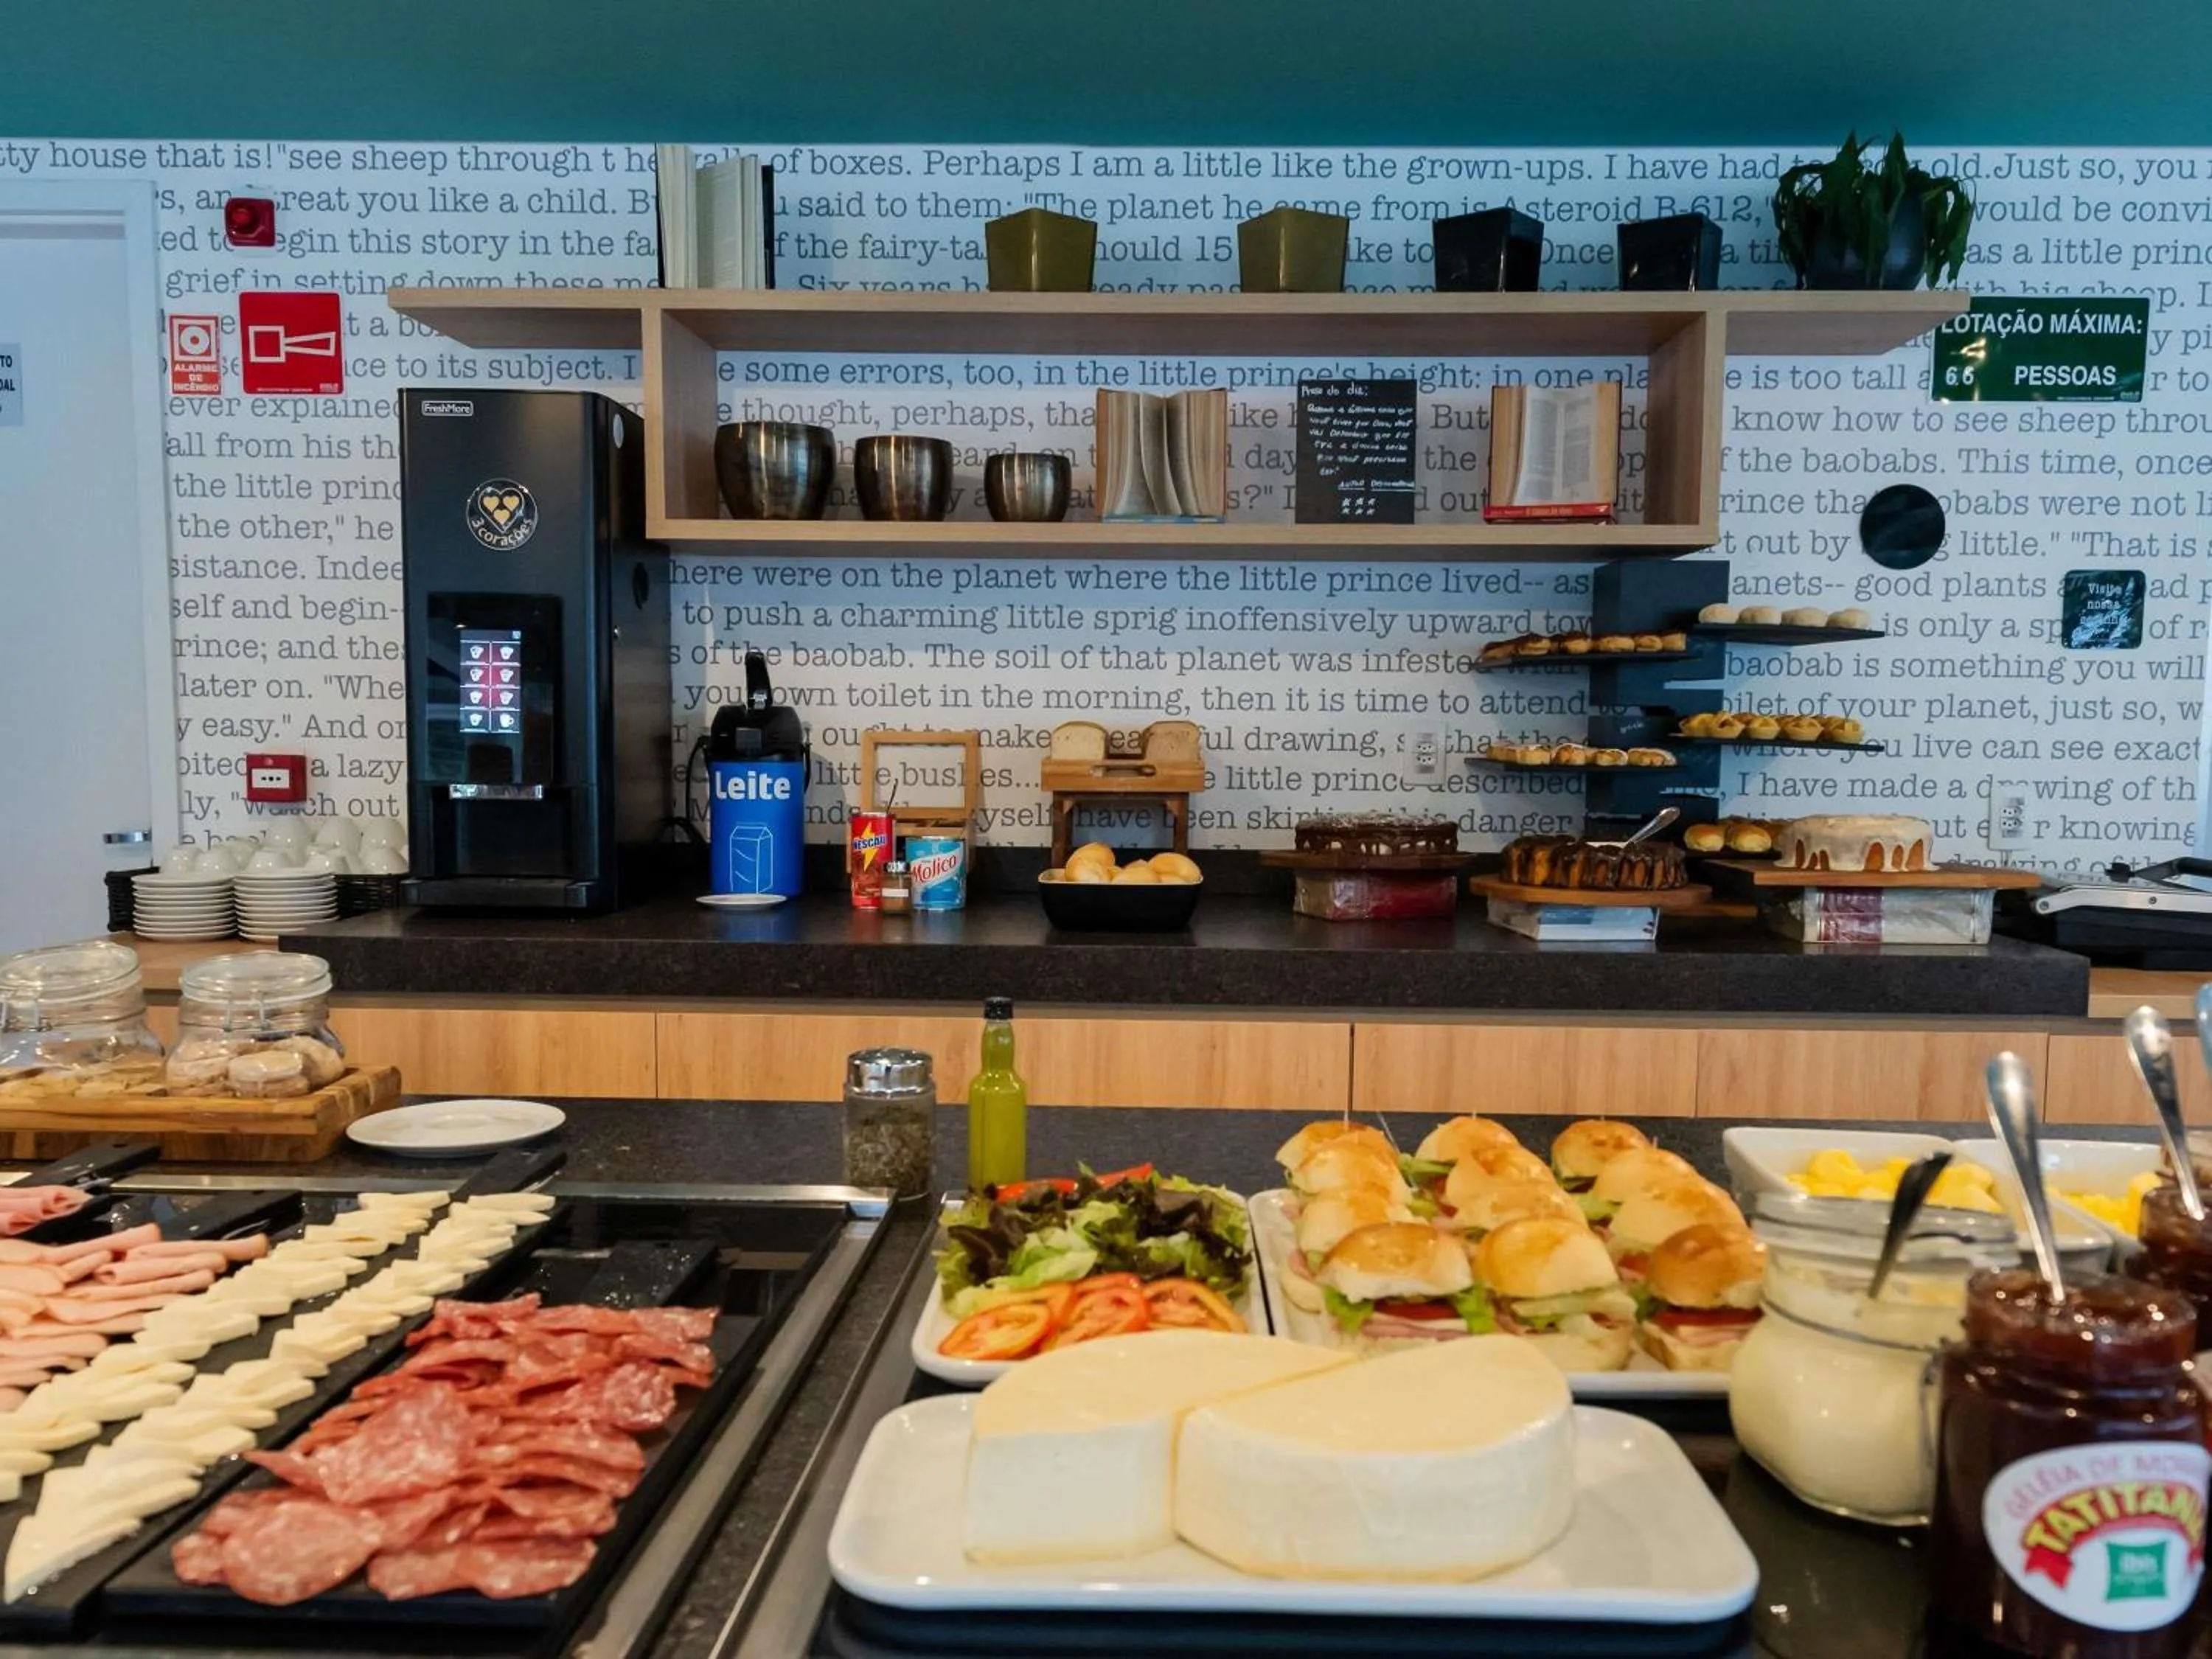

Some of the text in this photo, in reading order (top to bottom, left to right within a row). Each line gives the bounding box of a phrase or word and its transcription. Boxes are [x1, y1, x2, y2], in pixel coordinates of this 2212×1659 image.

[49, 142, 2198, 187] house that sheep through boxes. Perhaps I am a little like the grown-ups. I have had so, you
[357, 187, 2111, 225] you like child. said to planet be
[348, 228, 2122, 264] this story in the the 15 little
[1941, 308, 2143, 338] LOTAÇÃO MÁXIMA:
[189, 374, 204, 383] DE
[396, 354, 1906, 390] to its subject. some errors, too, in the little is too tall
[2014, 366, 2116, 386] PESSOAS
[169, 398, 2115, 439] ever perhaps, know how to see sheep
[216, 432, 2123, 481] from his the the baobabs. This time,
[173, 473, 2186, 516] the little were not
[178, 513, 2197, 562] the other," he by little." "That is
[753, 563, 2046, 602] were on the planet where the little prince good plants
[232, 594, 1992, 644] and to push charming little sprig inoffensively upward only
[278, 635, 2136, 685] and baobab. The soil of that planet was baobab is something you
[179, 672, 2166, 726] later on. toilet in the morning, then it is time to attend planet, just so,
[202, 714, 2104, 760] easy." And drawing, live can see
[337, 754, 1937, 799] lazy little have made
[715, 771, 791, 801] Leite
[348, 793, 1573, 841] out danger
